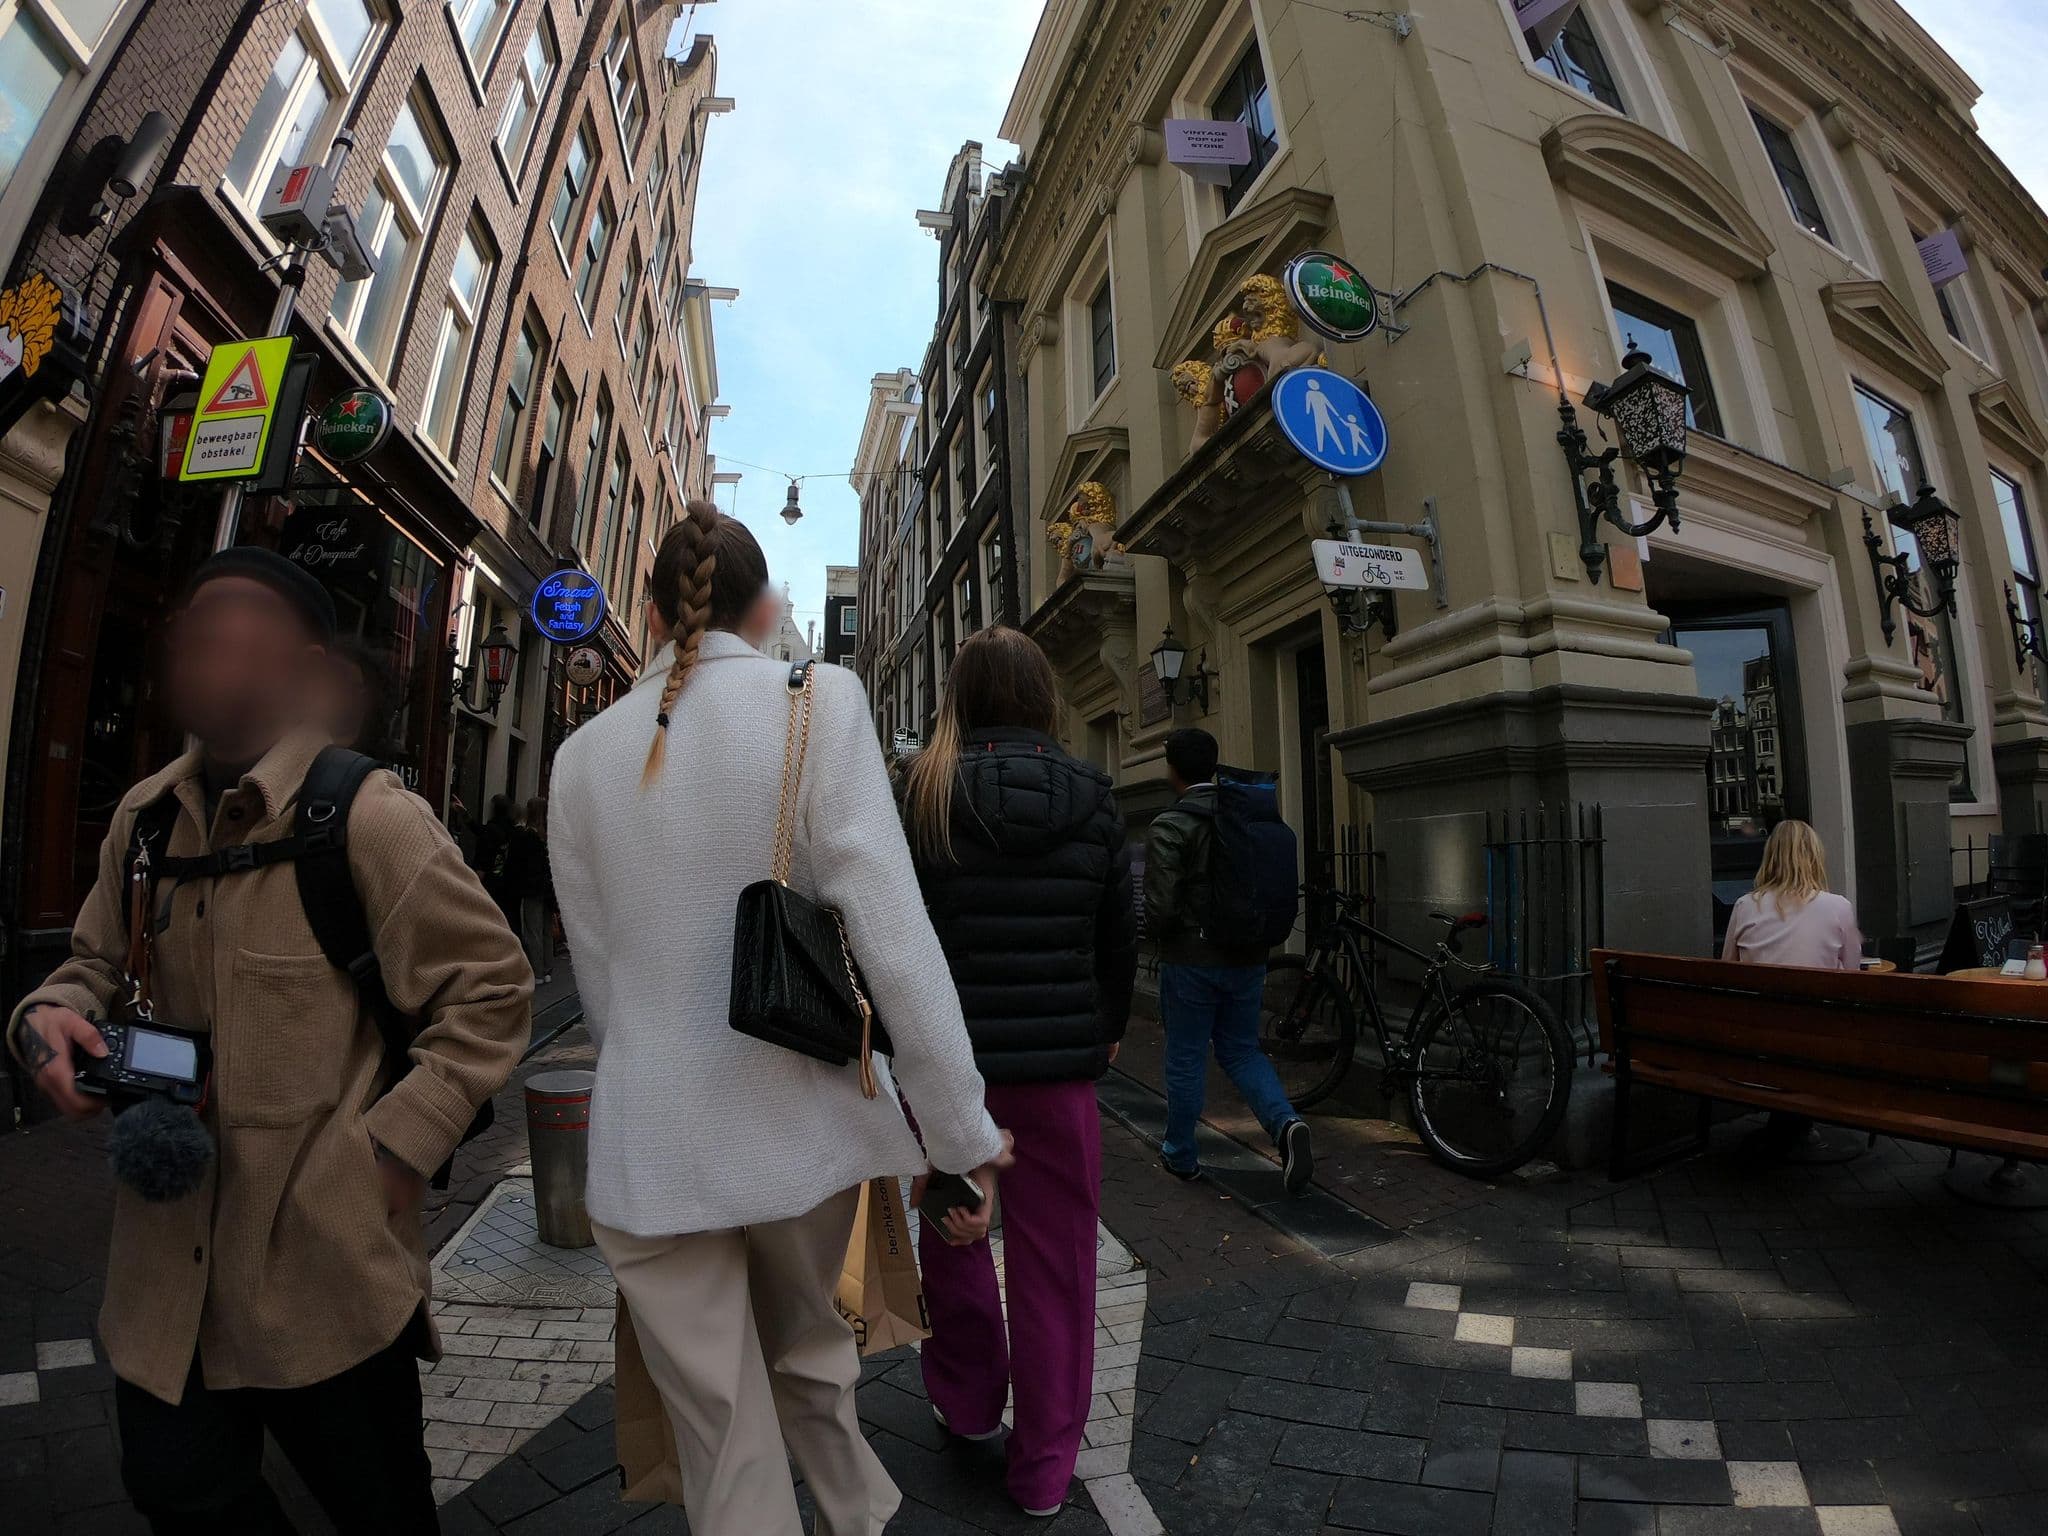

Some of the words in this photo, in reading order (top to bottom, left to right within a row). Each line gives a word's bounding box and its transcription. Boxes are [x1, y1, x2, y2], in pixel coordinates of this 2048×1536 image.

[1307, 284, 1371, 313] Heineken
[321, 419, 375, 437] Heineken
[196, 431, 258, 445] beweegbaar
[201, 446, 246, 460] obstakel
[288, 543, 304, 560] de
[1338, 544, 1403, 562] UITGEZONDERD
[543, 581, 596, 598] Smart
[554, 601, 581, 612] Fetish
[560, 611, 575, 621] and
[548, 619, 584, 632] Fantasy
